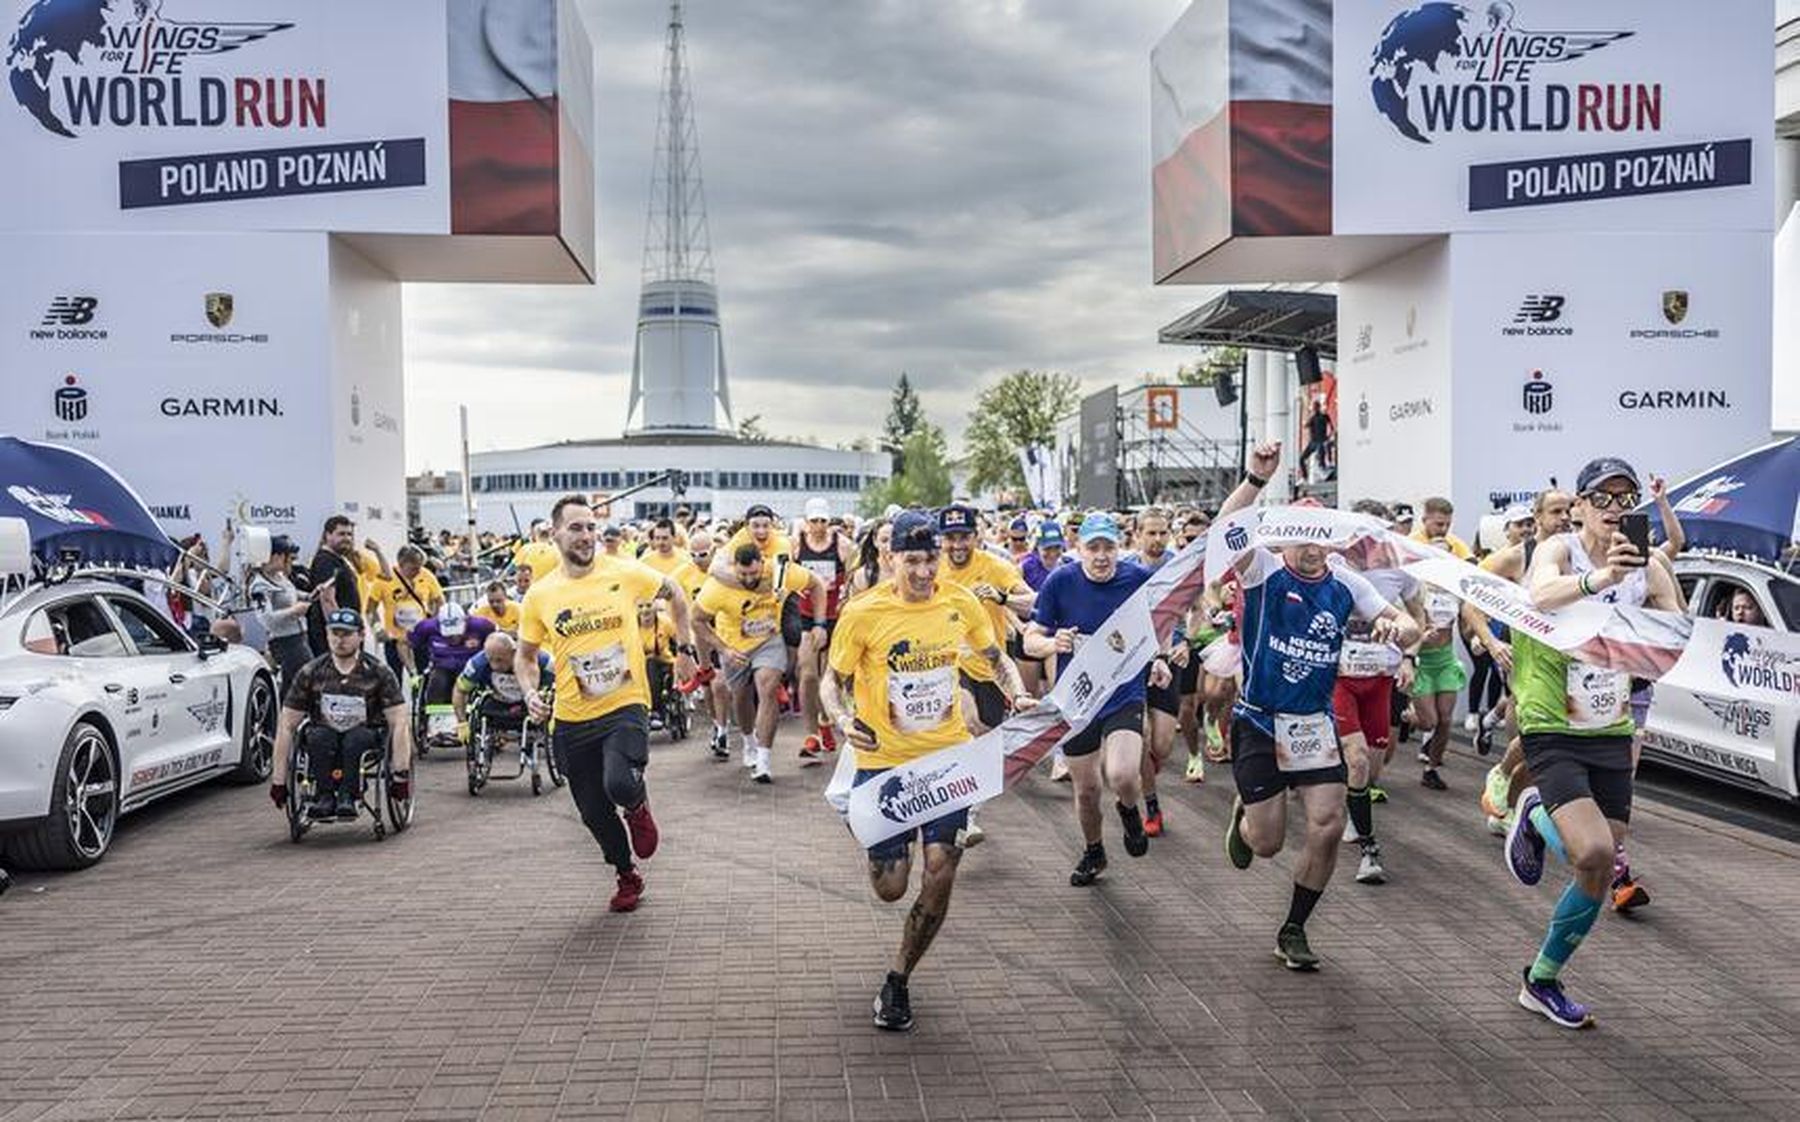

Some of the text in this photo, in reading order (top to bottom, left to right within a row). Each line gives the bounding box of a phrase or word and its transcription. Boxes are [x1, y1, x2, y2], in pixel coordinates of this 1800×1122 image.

[107, 25, 220, 49] WINGS
[1462, 35, 1566, 58] WINGS
[122, 51, 188, 74] LIFE
[1475, 59, 1536, 81] LIFE
[62, 76, 326, 128] WORLD RUN
[1420, 83, 1661, 132] WORLD RUN
[160, 141, 387, 198] POLAND POZNAŃ
[1507, 143, 1716, 200] POLAND POZNAŃ
[30, 328, 107, 339] new balance
[170, 334, 268, 343] PORSCHE
[1502, 326, 1573, 336] new balance
[1630, 330, 1719, 338] PORSCHE
[251, 505, 296, 518] InPost
[1257, 525, 1332, 539] GARMIN
[1738, 663, 1792, 692] WORLD
[906, 699, 941, 717] 9813
[896, 776, 979, 818] WORLD RUN
